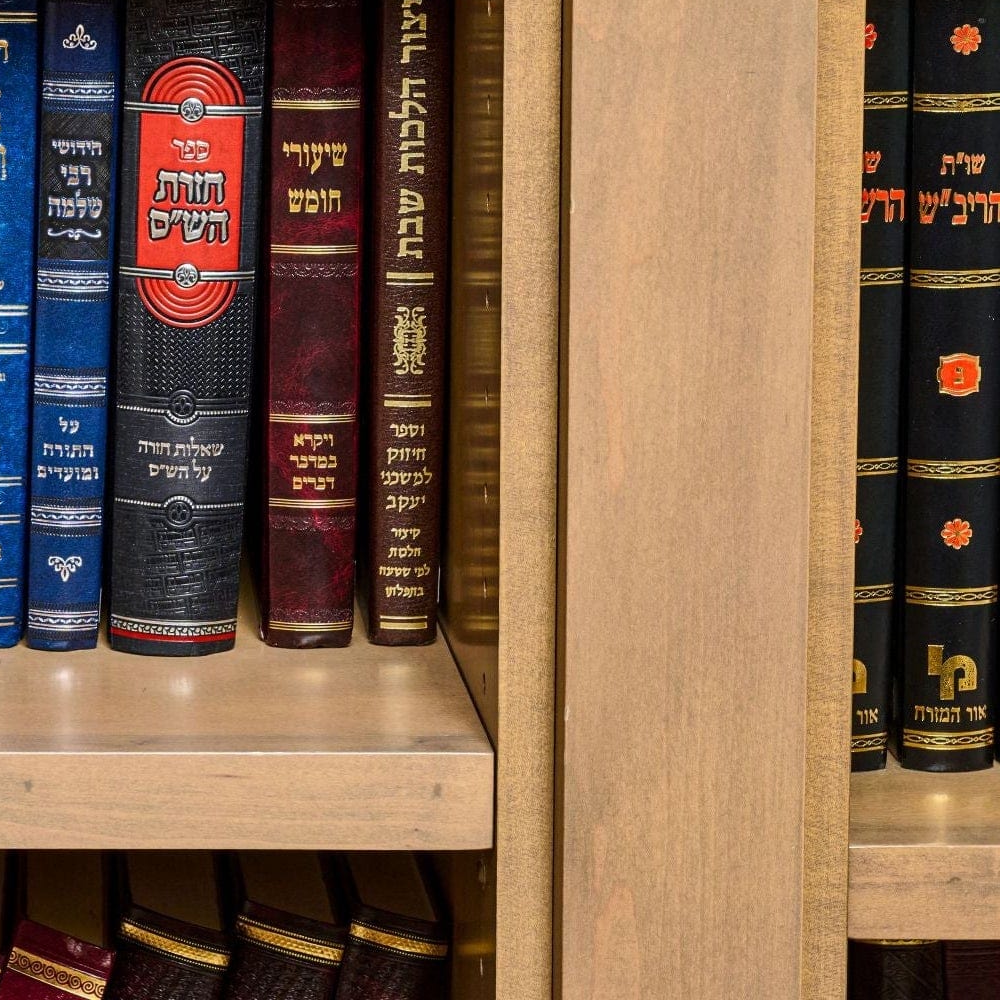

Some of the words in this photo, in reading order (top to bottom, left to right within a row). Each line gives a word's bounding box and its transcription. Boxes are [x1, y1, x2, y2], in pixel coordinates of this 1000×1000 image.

[171, 138, 211, 162] ספר
[282, 141, 348, 175] שיעורי
[48, 189, 103, 219] שלמה
[288, 188, 341, 213] חומש
[43, 442, 95, 459] התורה
[174, 436, 224, 457] שאלות
[293, 432, 334, 449] ויקרא
[192, 462, 212, 482] על
[289, 454, 337, 470] במדבר
[292, 476, 335, 491] דברים
[914, 705, 961, 723] המזרח
